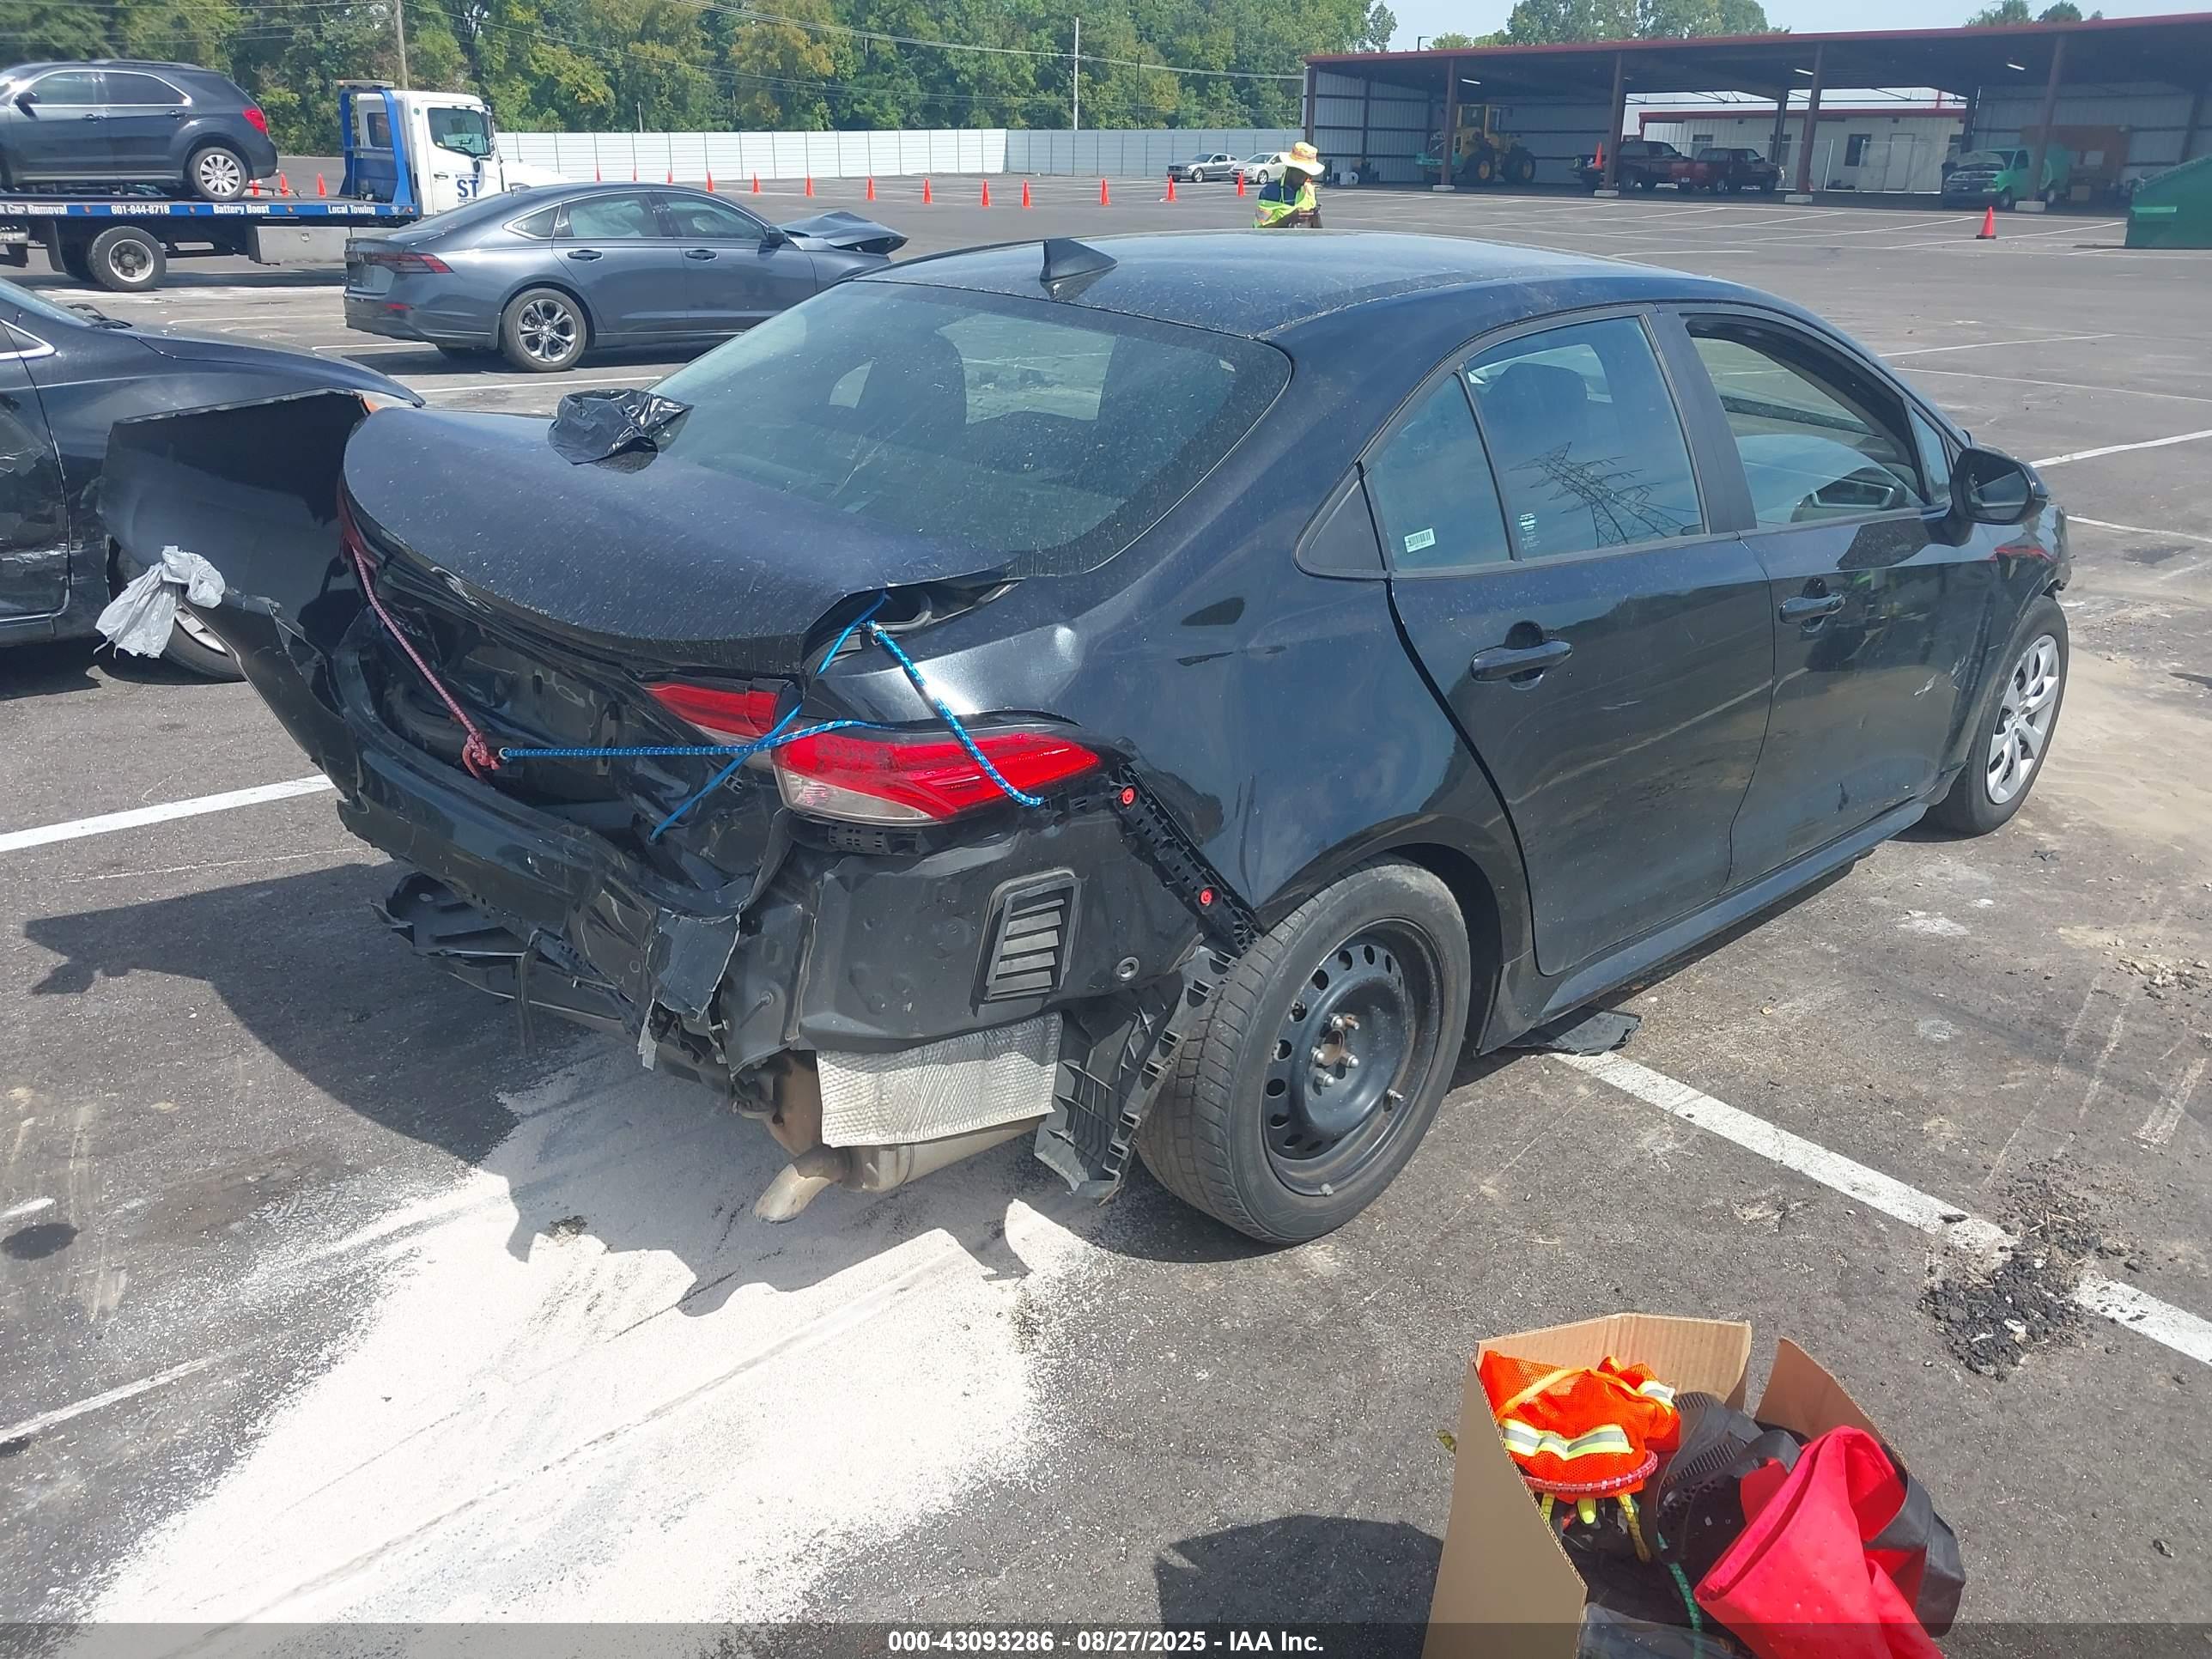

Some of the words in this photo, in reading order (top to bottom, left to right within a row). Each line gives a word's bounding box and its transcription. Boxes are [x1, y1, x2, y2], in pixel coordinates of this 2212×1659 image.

[457, 179, 479, 198] ST
[8, 204, 26, 214] Car
[27, 204, 68, 215] Removal
[213, 204, 245, 215] Battery
[246, 204, 270, 214] Boost
[328, 205, 348, 214] Local
[349, 205, 376, 215] Towing
